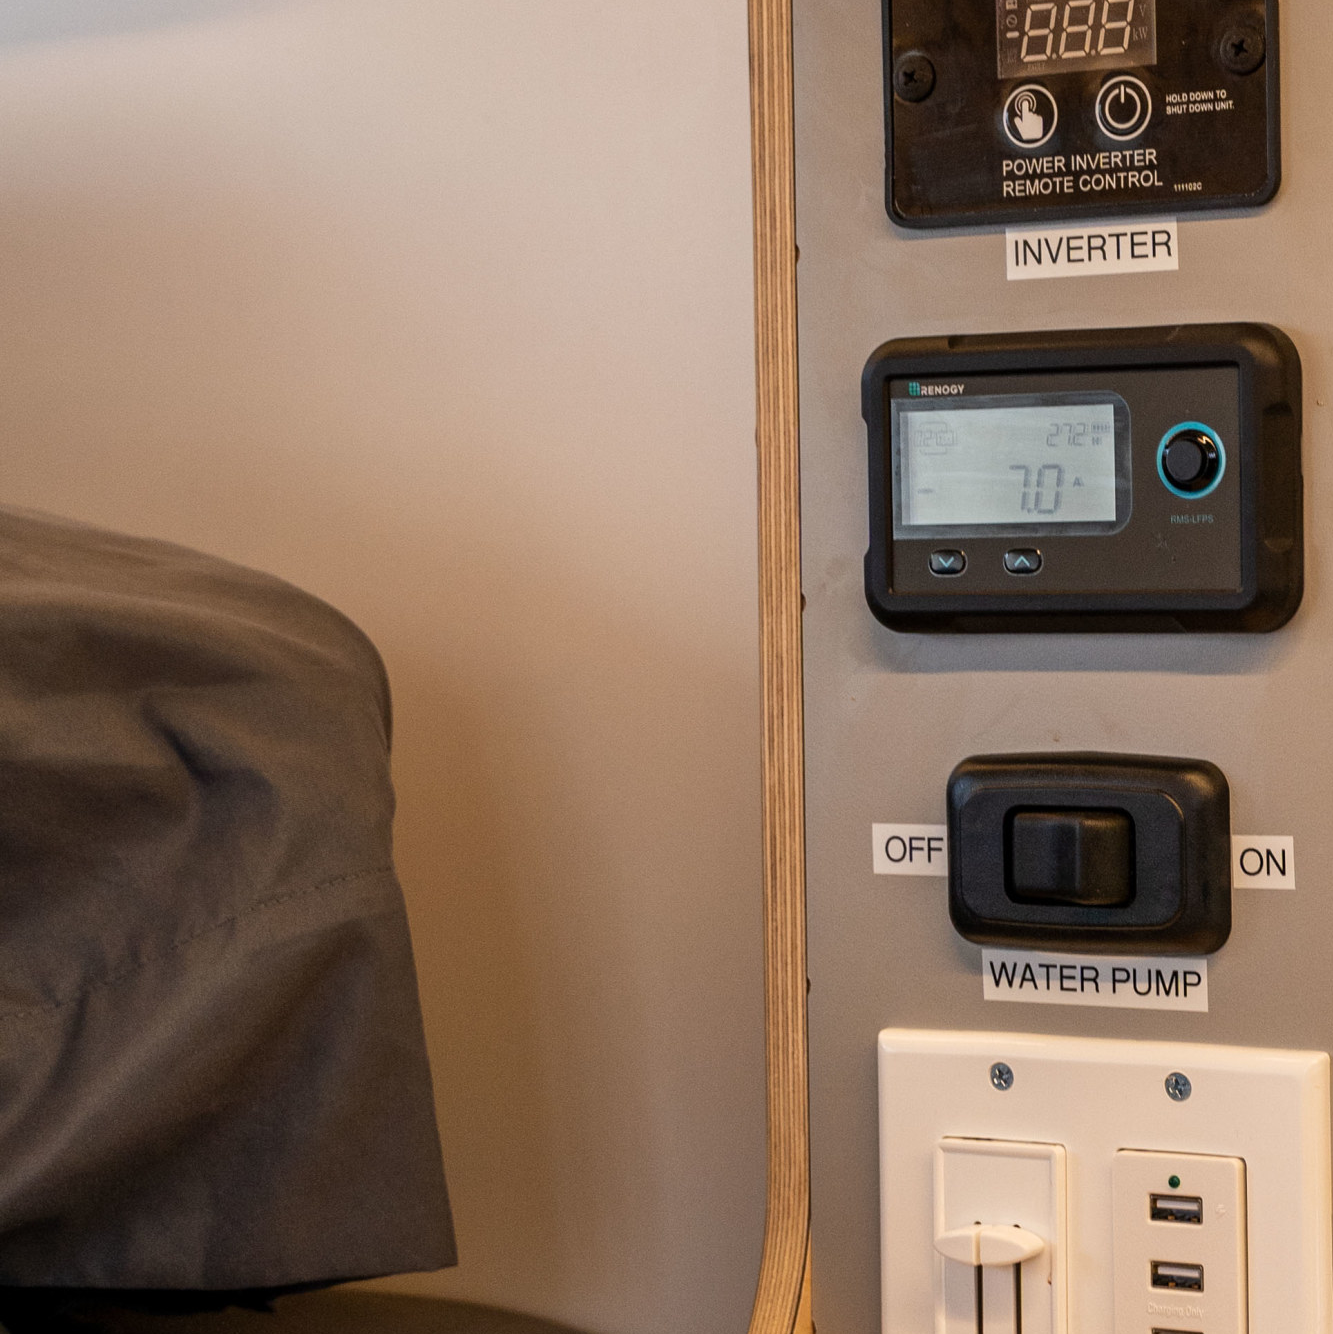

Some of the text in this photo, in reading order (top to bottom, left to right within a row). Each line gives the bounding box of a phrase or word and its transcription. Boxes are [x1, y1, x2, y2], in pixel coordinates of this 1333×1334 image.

[1165, 88, 1227, 104] HOLD DOWN TO
[1165, 104, 1188, 115] SHUT
[1188, 102, 1214, 113] DOWN
[1002, 148, 1158, 177] POWER INVERTER
[1003, 169, 1163, 198] REMOTE CONTROL
[1014, 229, 1173, 267] INVERTER
[920, 383, 965, 396] RENOGY
[884, 835, 944, 864] OFF
[1239, 847, 1287, 877] ON
[989, 960, 1202, 998] WATER PUMP
[1146, 1301, 1204, 1320] Charging Only
